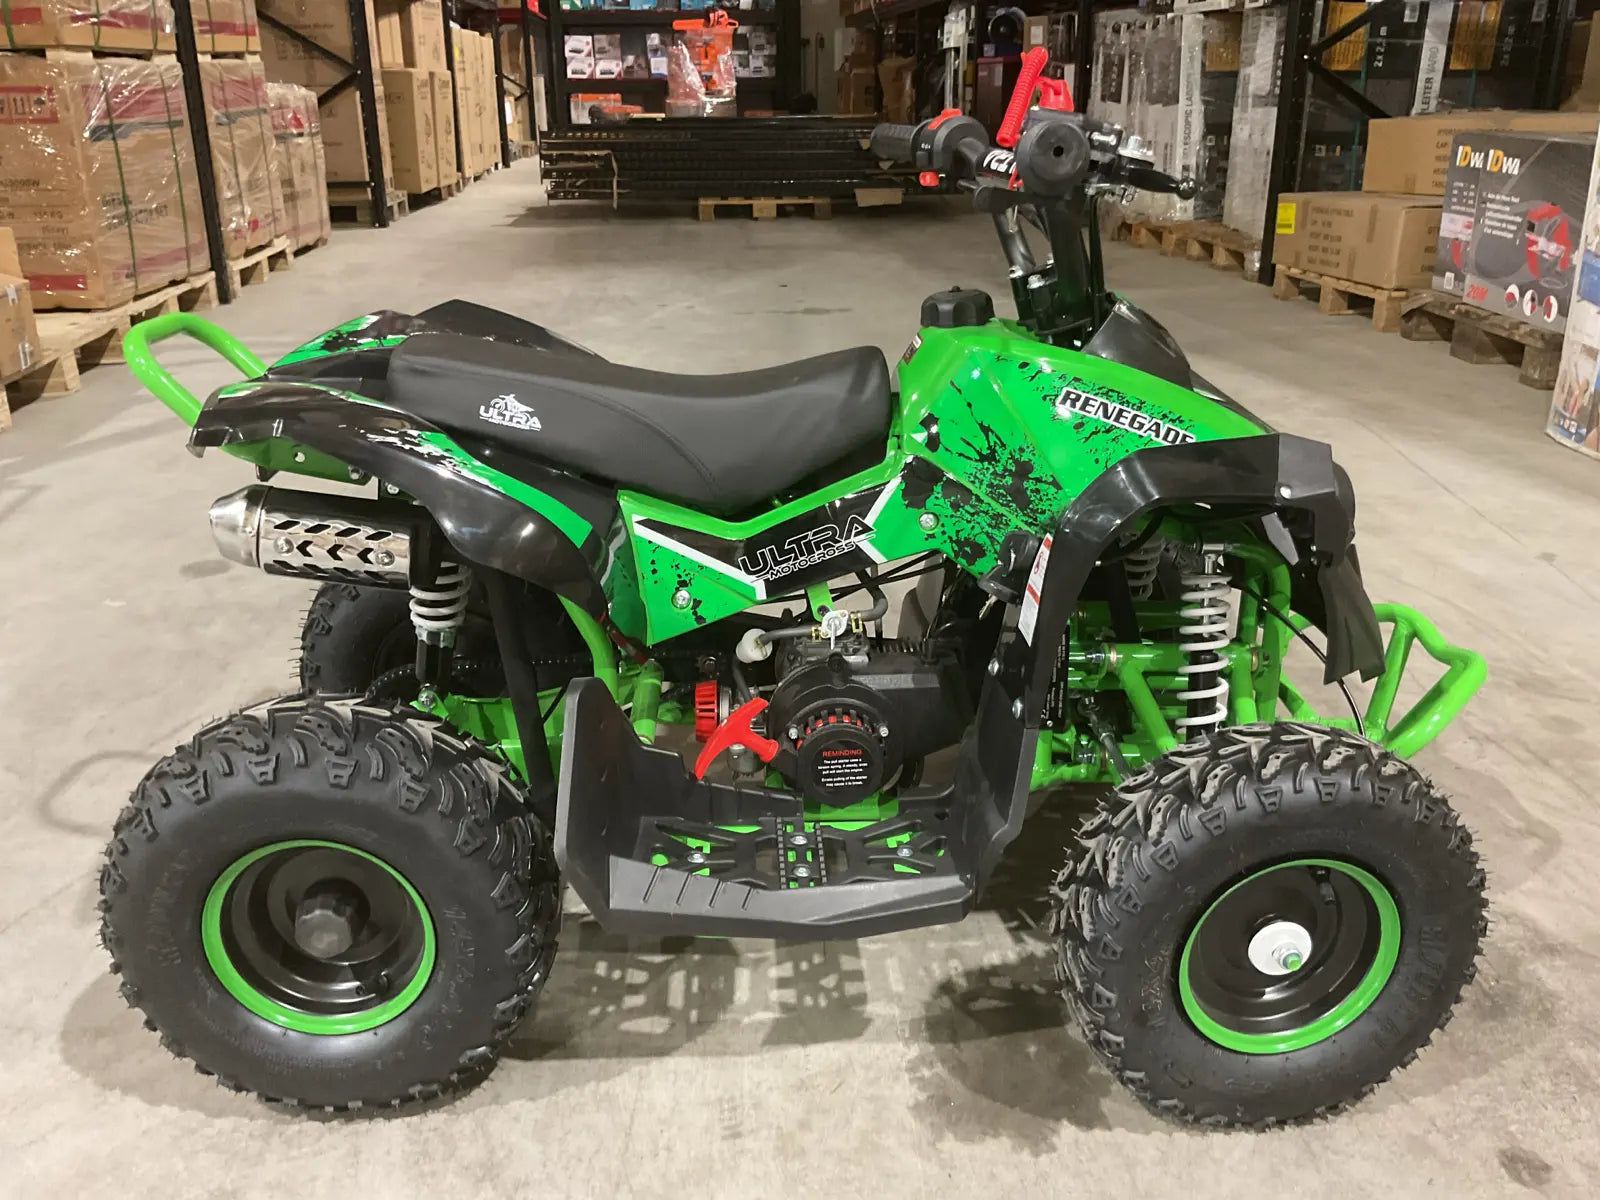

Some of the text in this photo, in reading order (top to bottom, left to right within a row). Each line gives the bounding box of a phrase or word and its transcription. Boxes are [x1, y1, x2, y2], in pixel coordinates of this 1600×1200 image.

[1420, 77, 1434, 112] LEITER
[479, 405, 542, 429] ULTRA
[738, 514, 877, 577] ULTRA
[769, 541, 856, 580] MOTOCROSS
[822, 749, 863, 757] REMINDING
